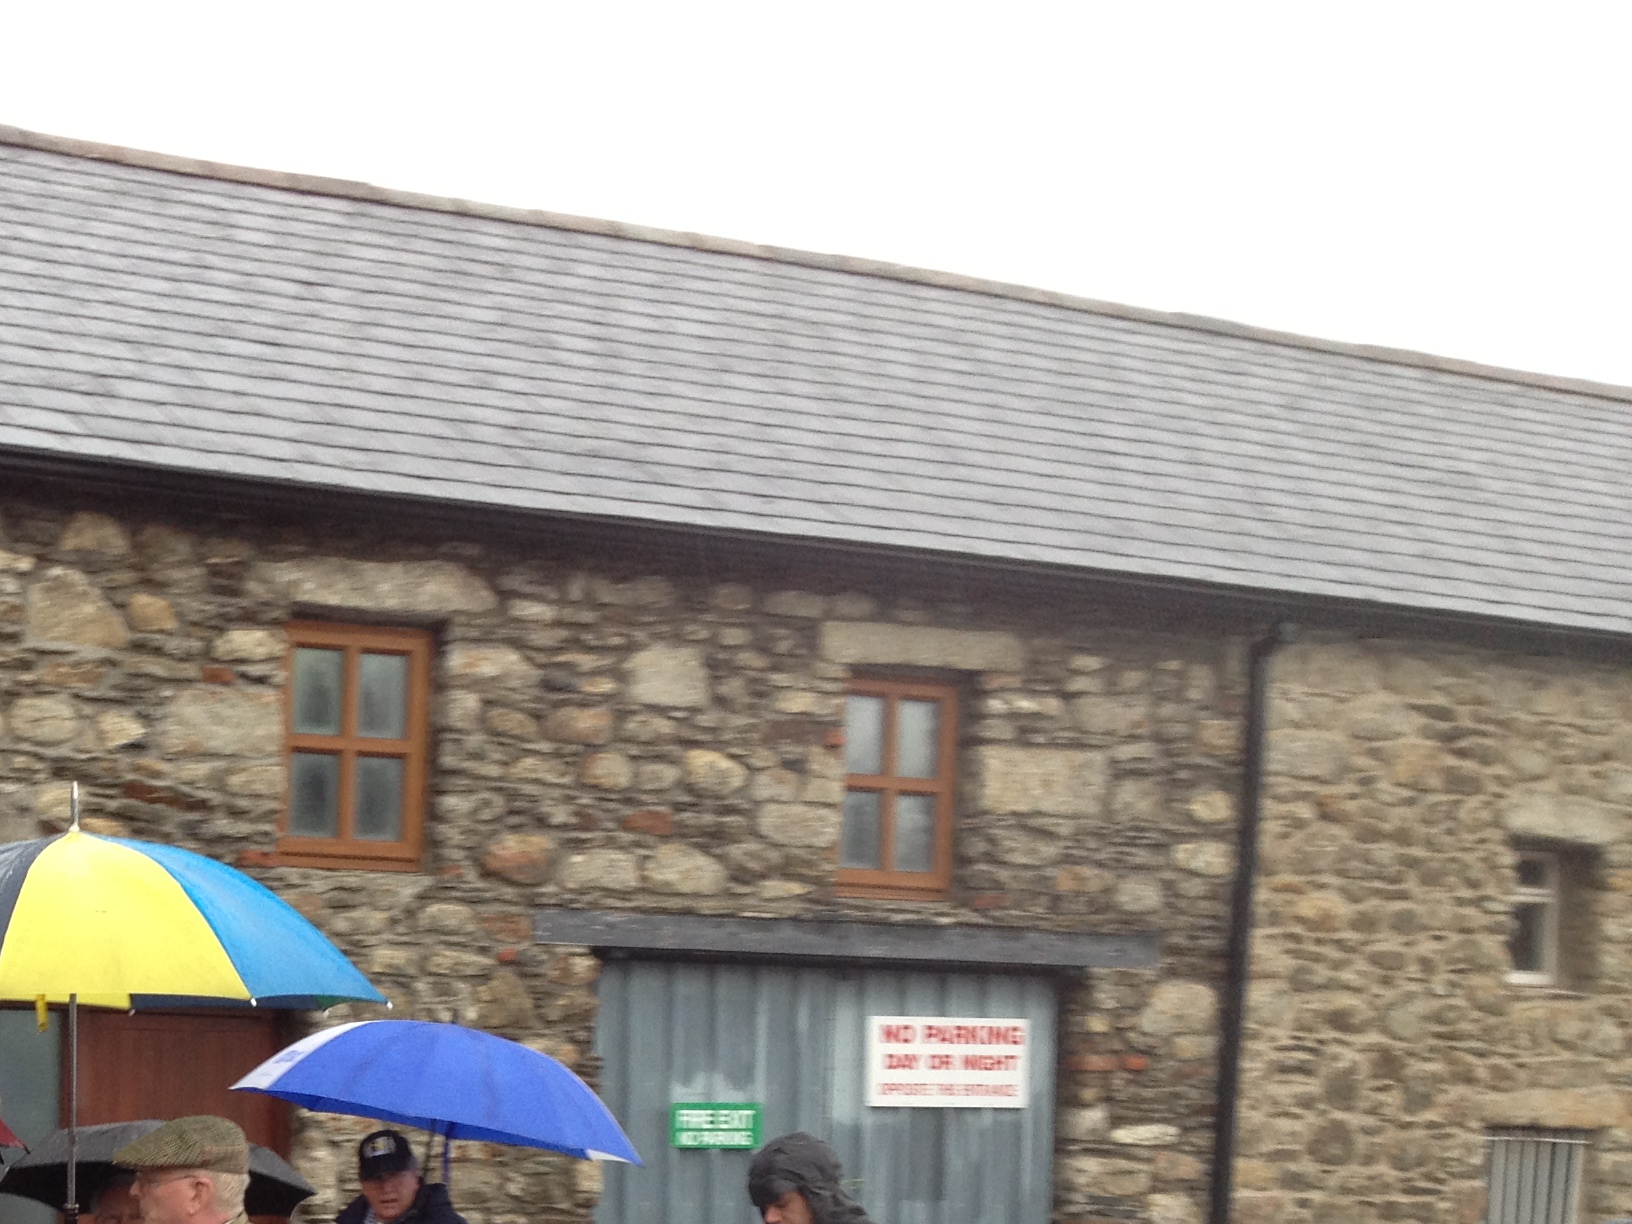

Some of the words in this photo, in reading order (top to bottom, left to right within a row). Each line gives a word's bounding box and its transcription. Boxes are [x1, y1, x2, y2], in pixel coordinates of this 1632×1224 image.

[880, 1024, 914, 1045] NO
[923, 1024, 1024, 1046] PARKING
[883, 1053, 917, 1070] DAY
[927, 1053, 953, 1071] OR
[961, 1054, 1018, 1071] NIGHT
[676, 1109, 715, 1129] FIRE
[718, 1109, 755, 1129] EXIT
